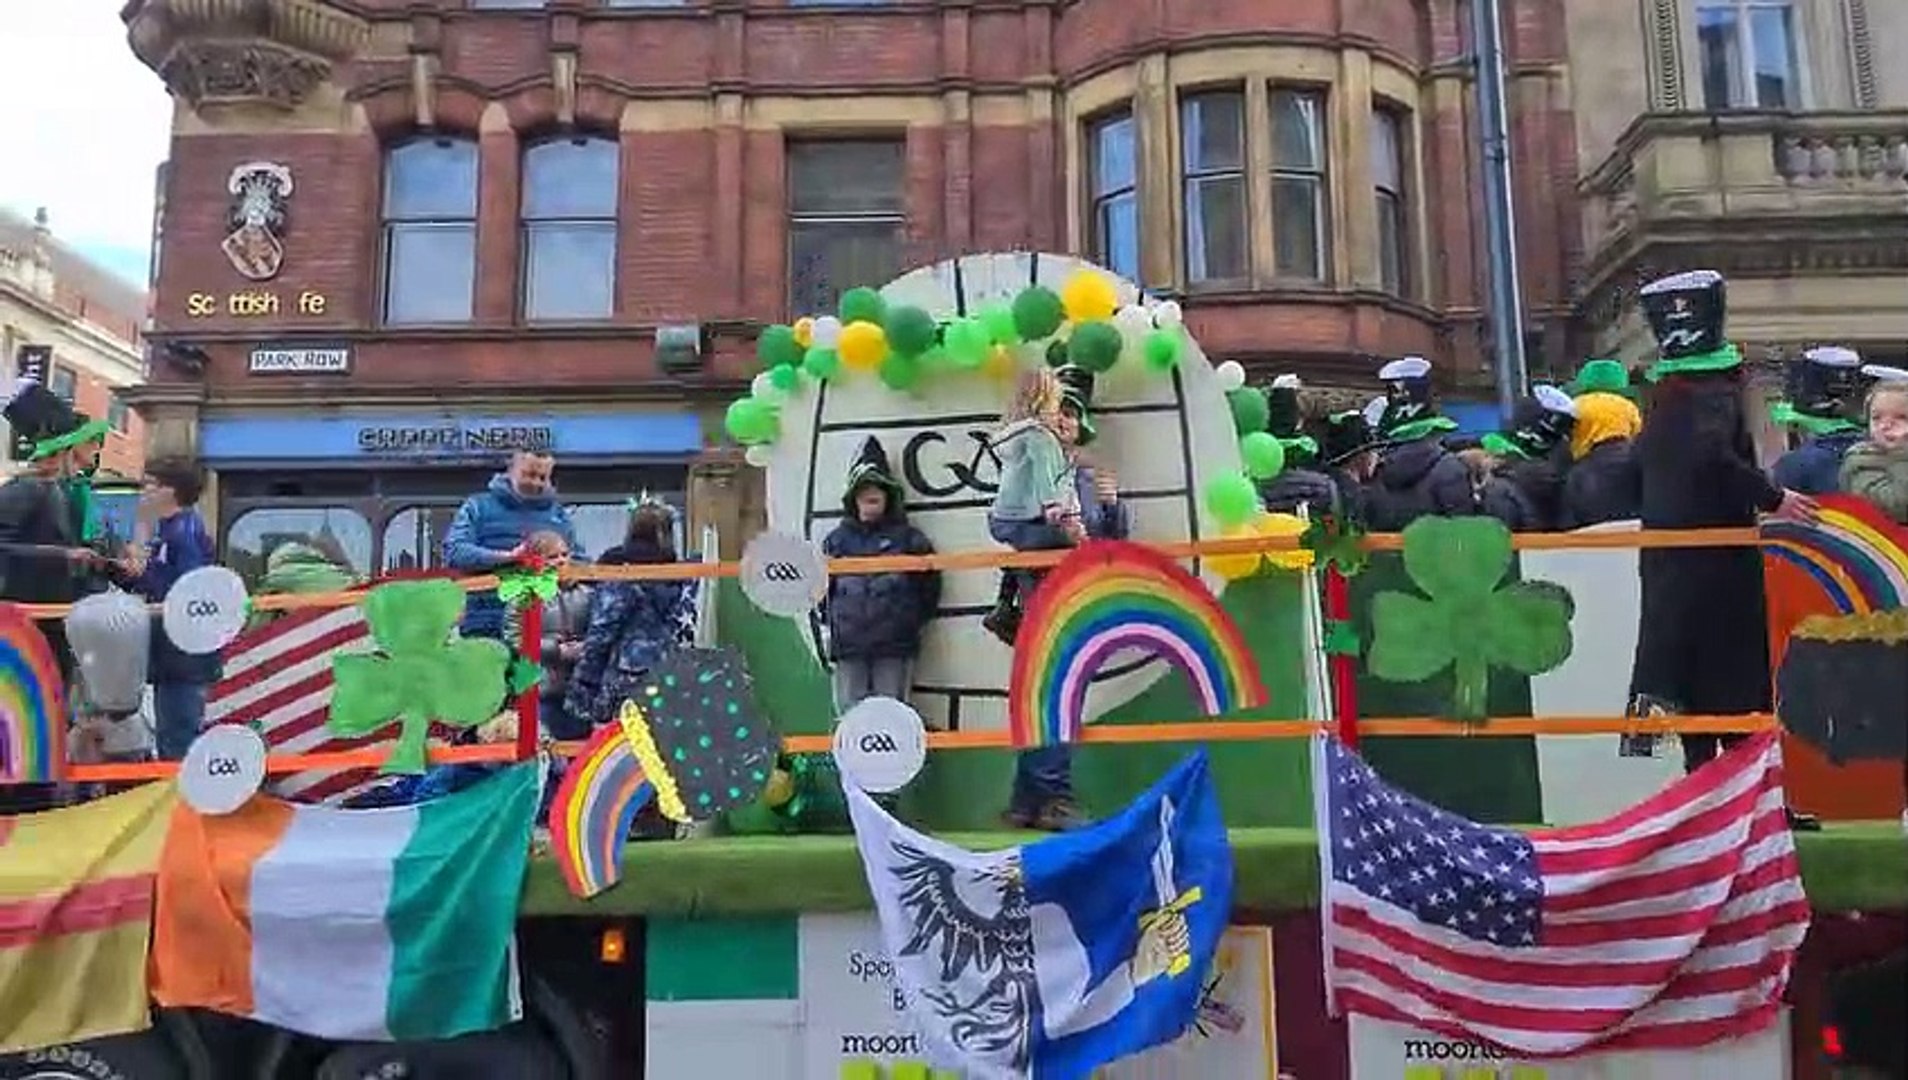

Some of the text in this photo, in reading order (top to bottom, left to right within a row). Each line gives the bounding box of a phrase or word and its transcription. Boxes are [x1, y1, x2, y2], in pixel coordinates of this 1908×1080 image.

[254, 351, 343, 369] PARK ROW
[848, 951, 895, 983] Spo
[840, 1033, 920, 1055] moort
